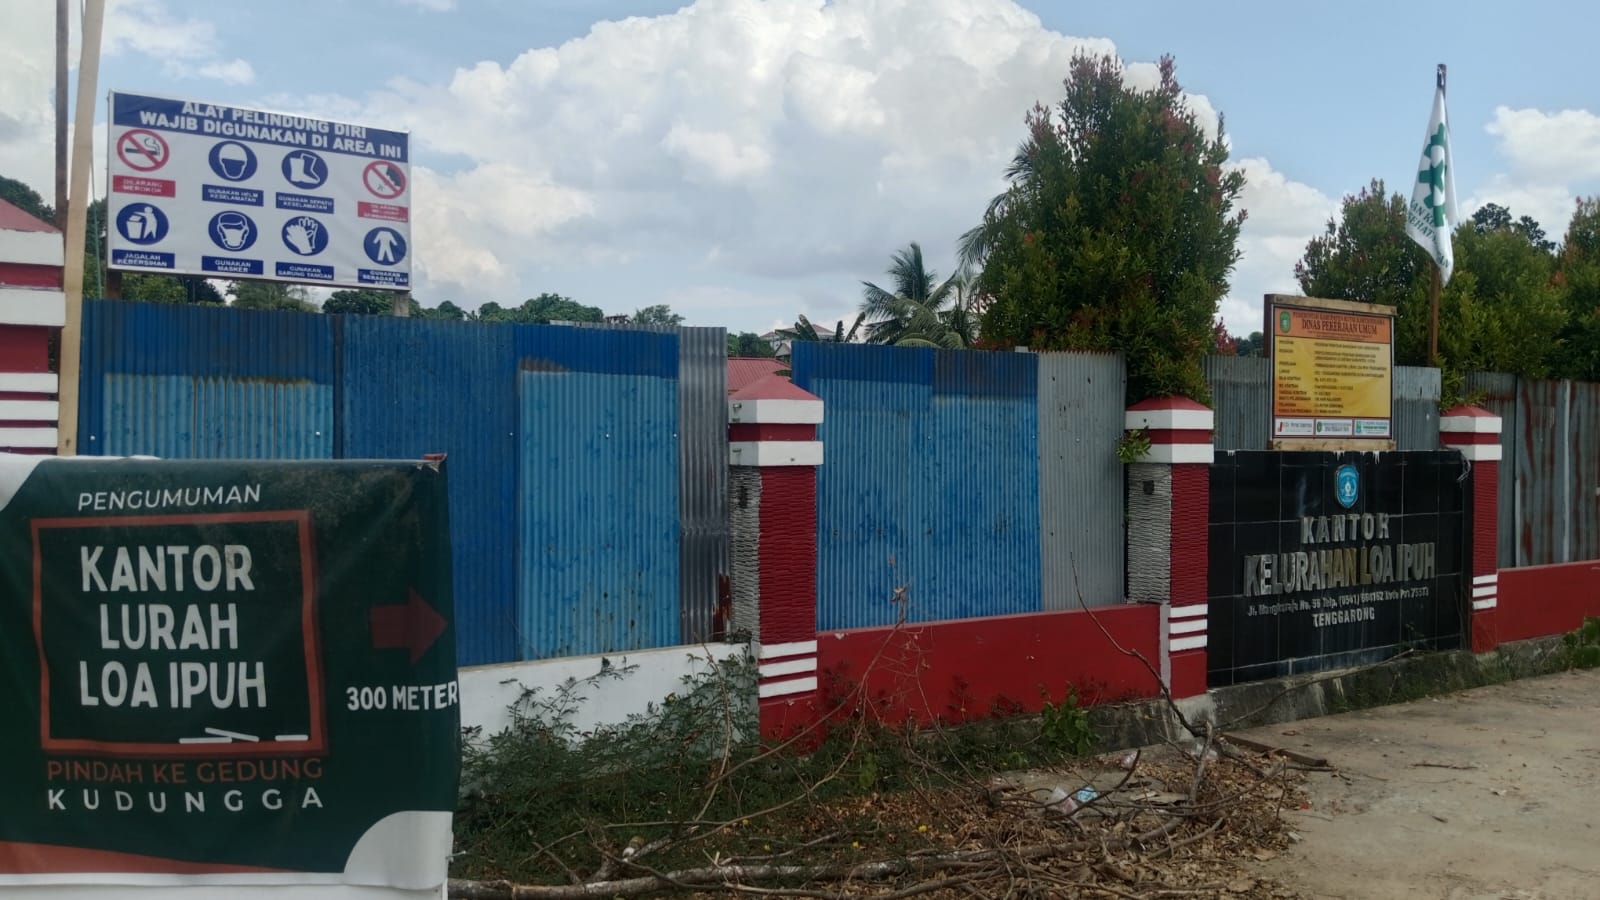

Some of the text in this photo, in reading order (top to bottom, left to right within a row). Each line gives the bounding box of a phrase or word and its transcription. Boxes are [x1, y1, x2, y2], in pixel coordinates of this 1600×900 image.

[182, 101, 367, 139] ALAT PELINDUNG DIRI
[139, 110, 402, 159] WAJIB DIGUNAKAN DI AREA INI
[208, 188, 240, 197] GUNAKAN
[278, 195, 308, 204] GUNAKAN
[124, 252, 161, 261] JAGALAH
[215, 259, 251, 267] GUNAKAN
[217, 265, 249, 273] MASKER
[289, 265, 322, 274] GUNAKAN
[1302, 319, 1321, 330] DINAS
[78, 484, 262, 511] PENGUMUMAN
[1300, 512, 1389, 544] KANTOR
[81, 544, 255, 592] KANTOR
[1243, 542, 1436, 597] KELURAHAN LOA IPUH
[99, 602, 239, 650] LURAH
[1313, 608, 1376, 628] TENGGARONG
[80, 660, 267, 709] LOA IPUH
[346, 680, 459, 711] 300 METER
[47, 757, 324, 783] PINDAH KE GEDUNG
[48, 787, 324, 812] KUDUNGGA
